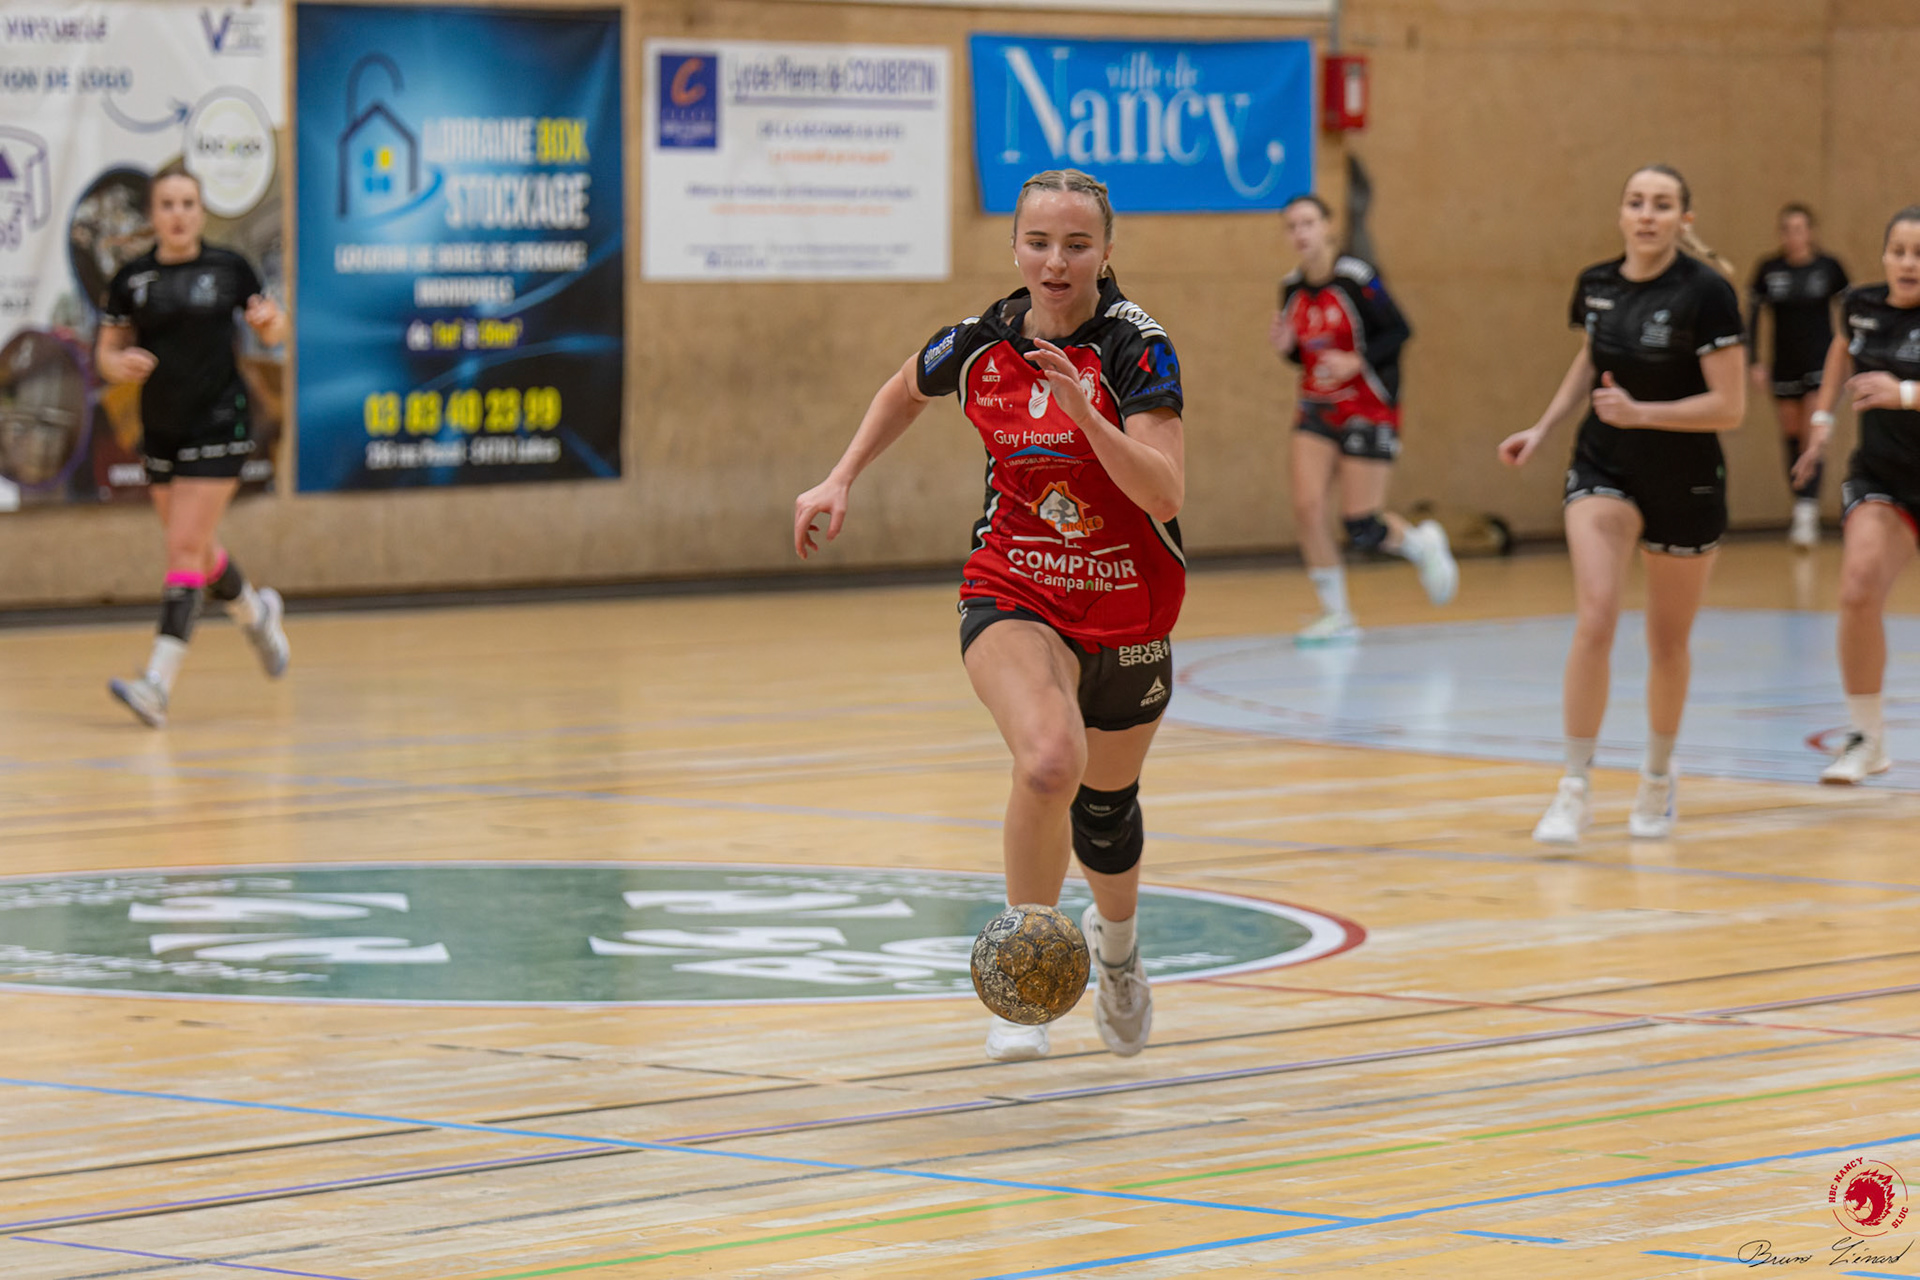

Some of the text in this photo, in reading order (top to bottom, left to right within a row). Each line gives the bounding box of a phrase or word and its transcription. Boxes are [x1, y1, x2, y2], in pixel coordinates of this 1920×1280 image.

[846, 58, 938, 95] COUBERTIN
[1106, 50, 1199, 89] ville de
[536, 117, 591, 165] BOX
[446, 173, 591, 229] STOCKAGE
[993, 429, 1075, 448] Guy Hoquet
[1007, 548, 1137, 579] COMPTOIR
[1033, 570, 1113, 593] Campanile
[1118, 640, 1161, 656] PAYS
[1140, 690, 1167, 707] SELECT
